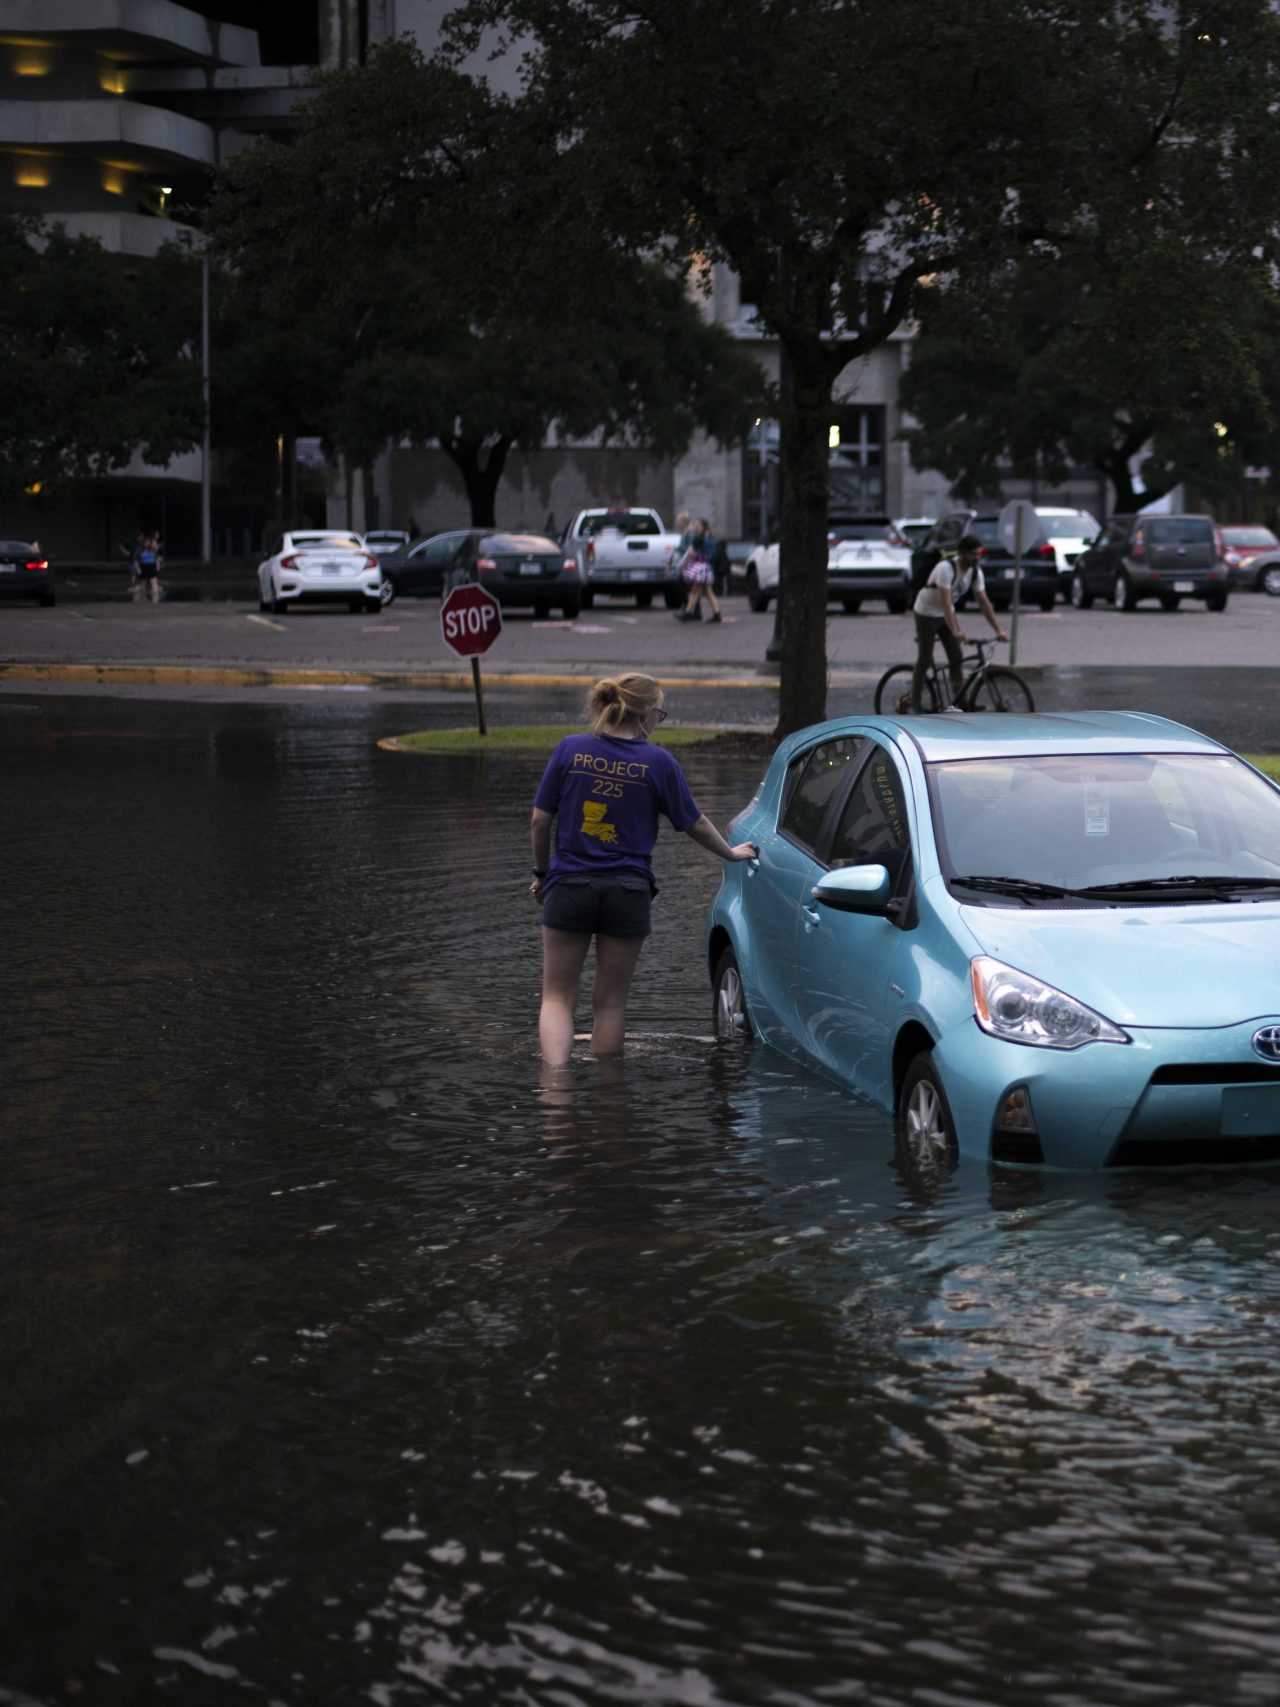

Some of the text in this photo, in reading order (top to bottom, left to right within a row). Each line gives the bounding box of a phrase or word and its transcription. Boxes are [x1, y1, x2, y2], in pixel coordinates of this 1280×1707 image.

[446, 604, 495, 638] STOP
[574, 754, 649, 778] PROJECT
[592, 779, 624, 798] 225
